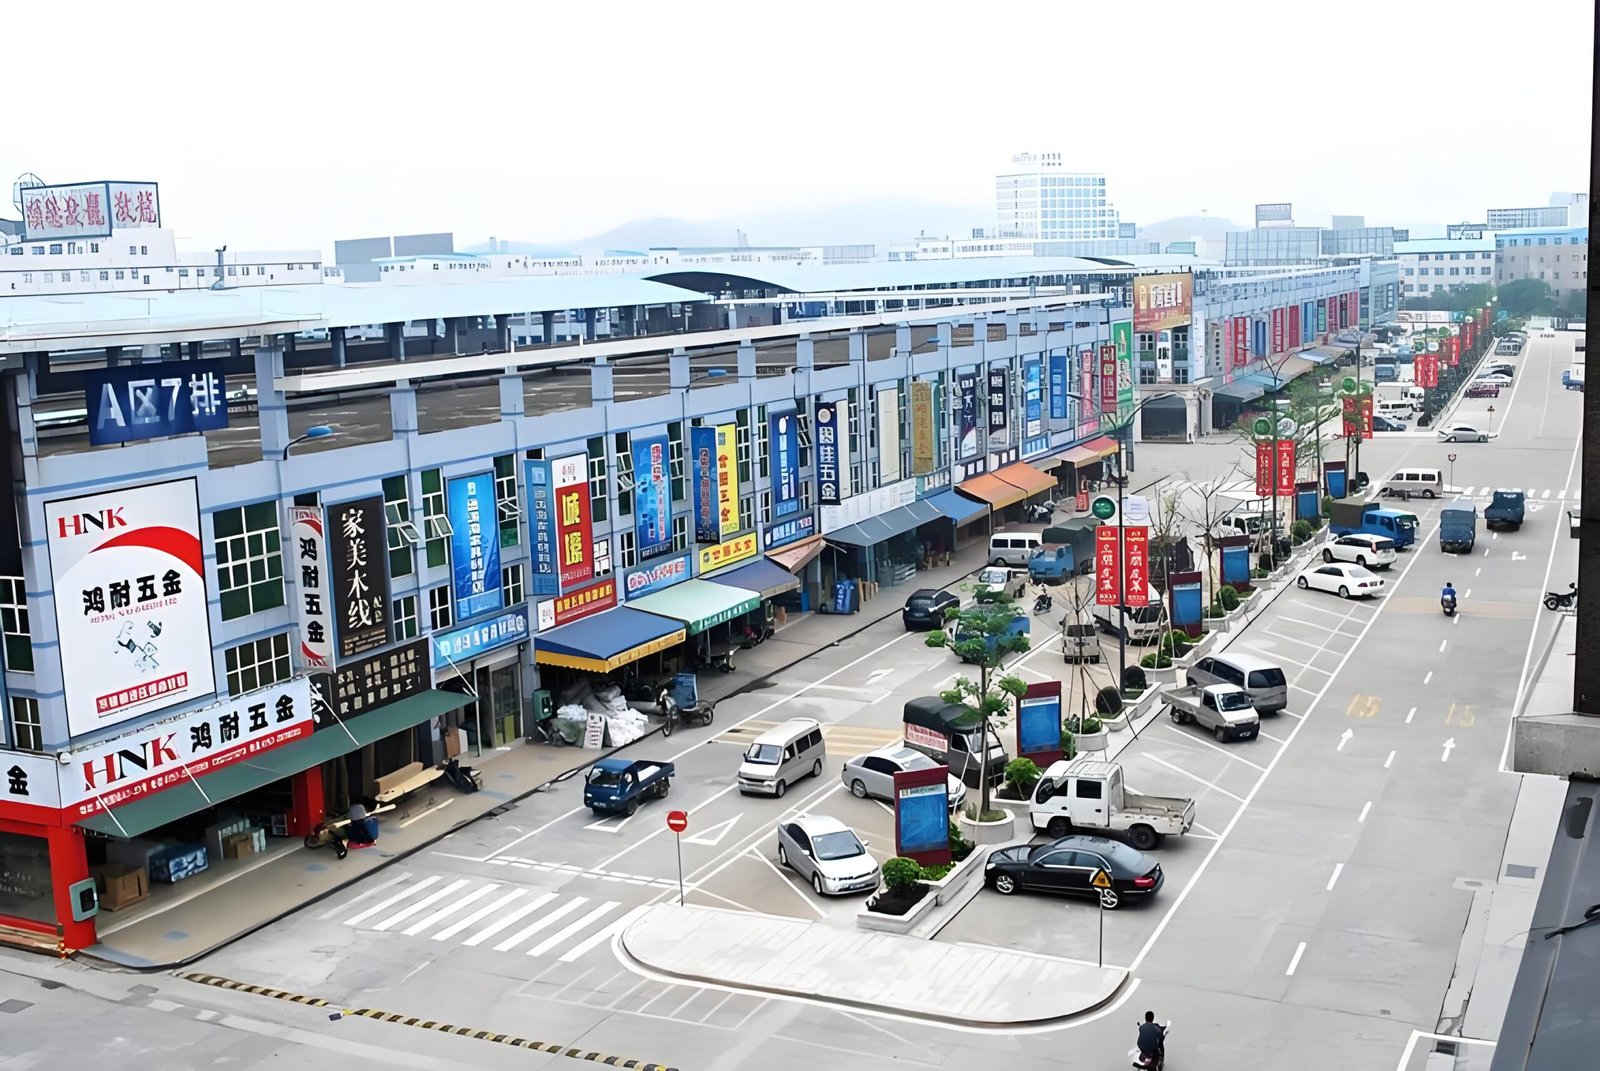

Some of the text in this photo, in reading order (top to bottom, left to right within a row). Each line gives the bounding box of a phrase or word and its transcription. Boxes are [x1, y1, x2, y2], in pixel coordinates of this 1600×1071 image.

[97, 372, 221, 430] A区7排
[58, 507, 127, 538] HNK
[342, 508, 373, 629] 家美木线
[7, 765, 29, 796] 金
[82, 732, 181, 792] HNK
